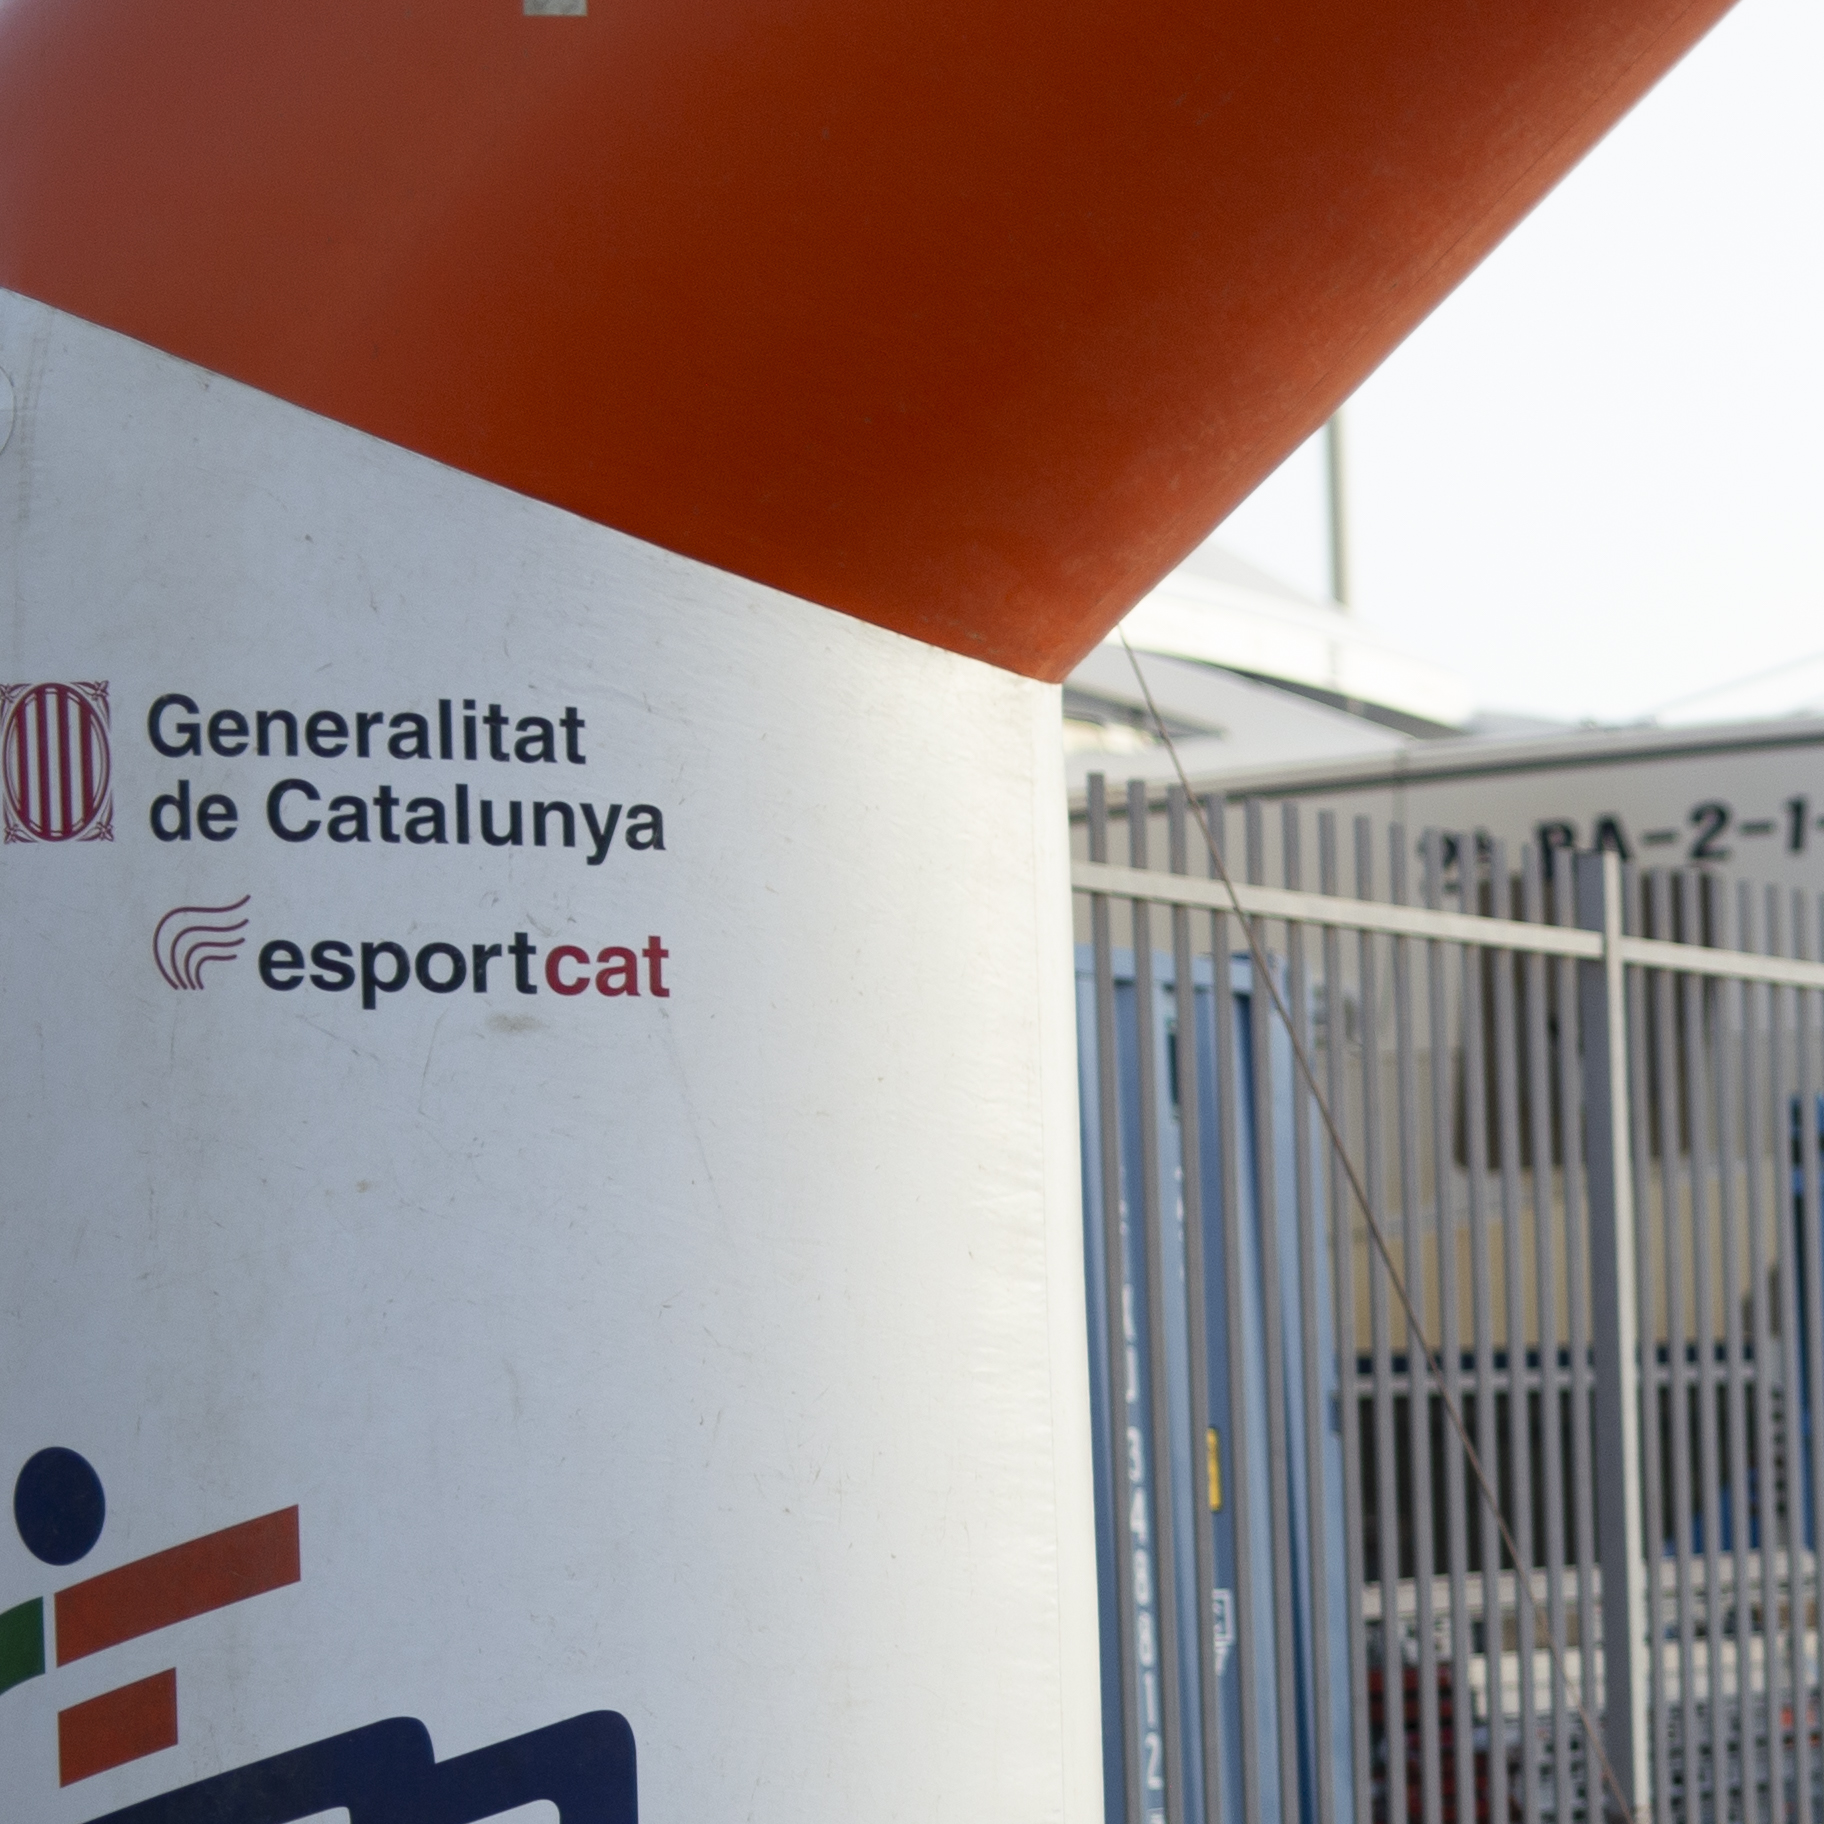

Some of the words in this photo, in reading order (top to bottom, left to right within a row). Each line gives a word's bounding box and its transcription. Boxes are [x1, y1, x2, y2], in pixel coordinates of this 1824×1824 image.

[147, 692, 586, 765] Generalitat
[149, 779, 239, 843] de
[266, 777, 666, 866] Catalunya
[257, 931, 670, 1011] esportcat
